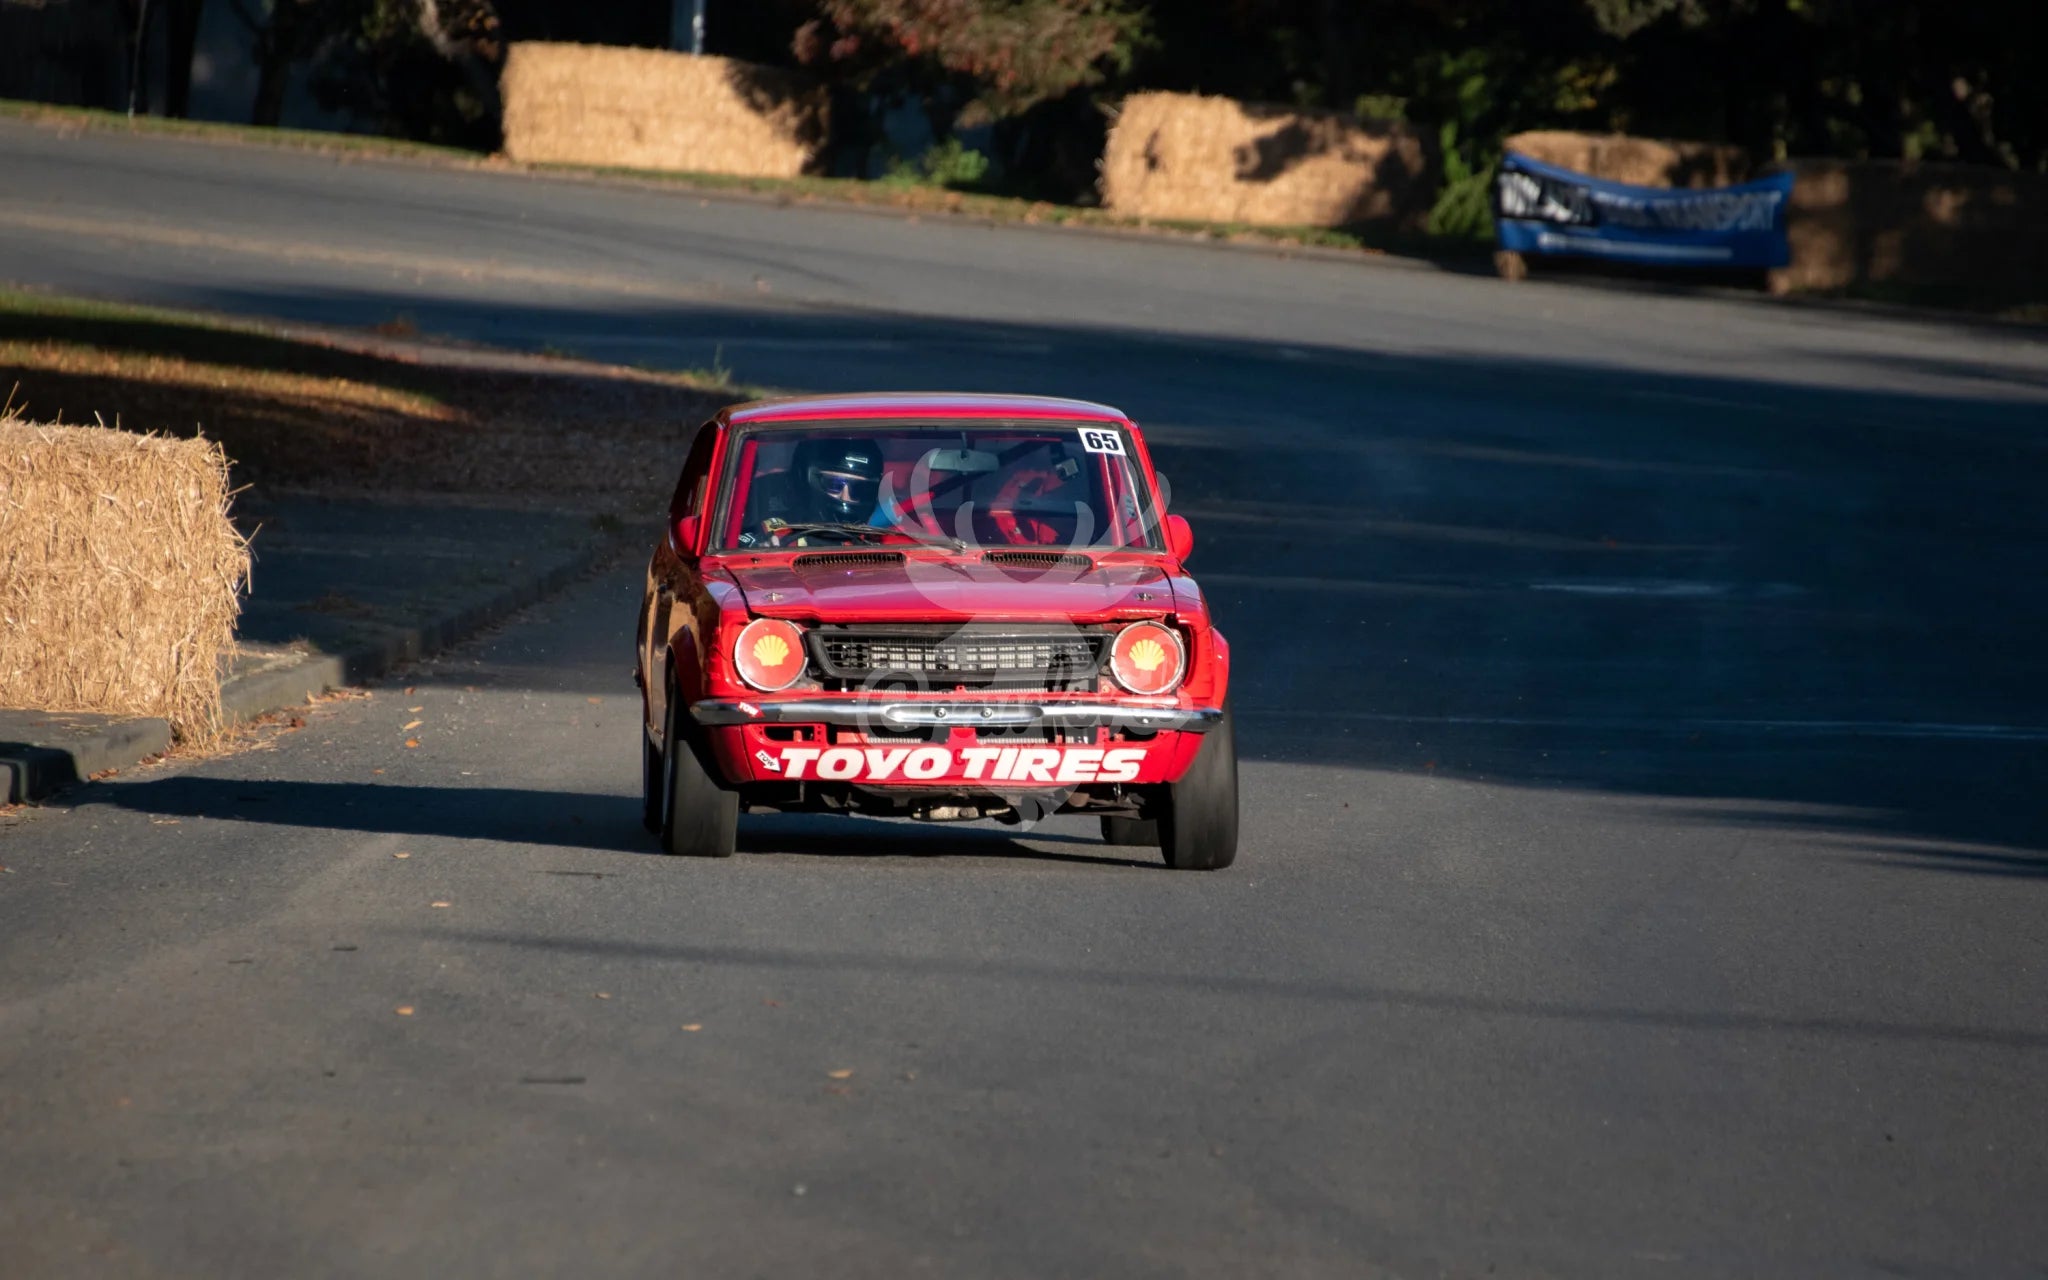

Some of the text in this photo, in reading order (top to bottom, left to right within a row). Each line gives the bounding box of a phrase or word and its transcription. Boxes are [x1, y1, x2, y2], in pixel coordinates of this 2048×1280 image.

[1084, 431, 1120, 451] 65
[738, 701, 759, 717] TOW
[758, 752, 776, 767] TOW
[779, 748, 952, 780] TOYO
[959, 748, 1148, 782] TIRES
